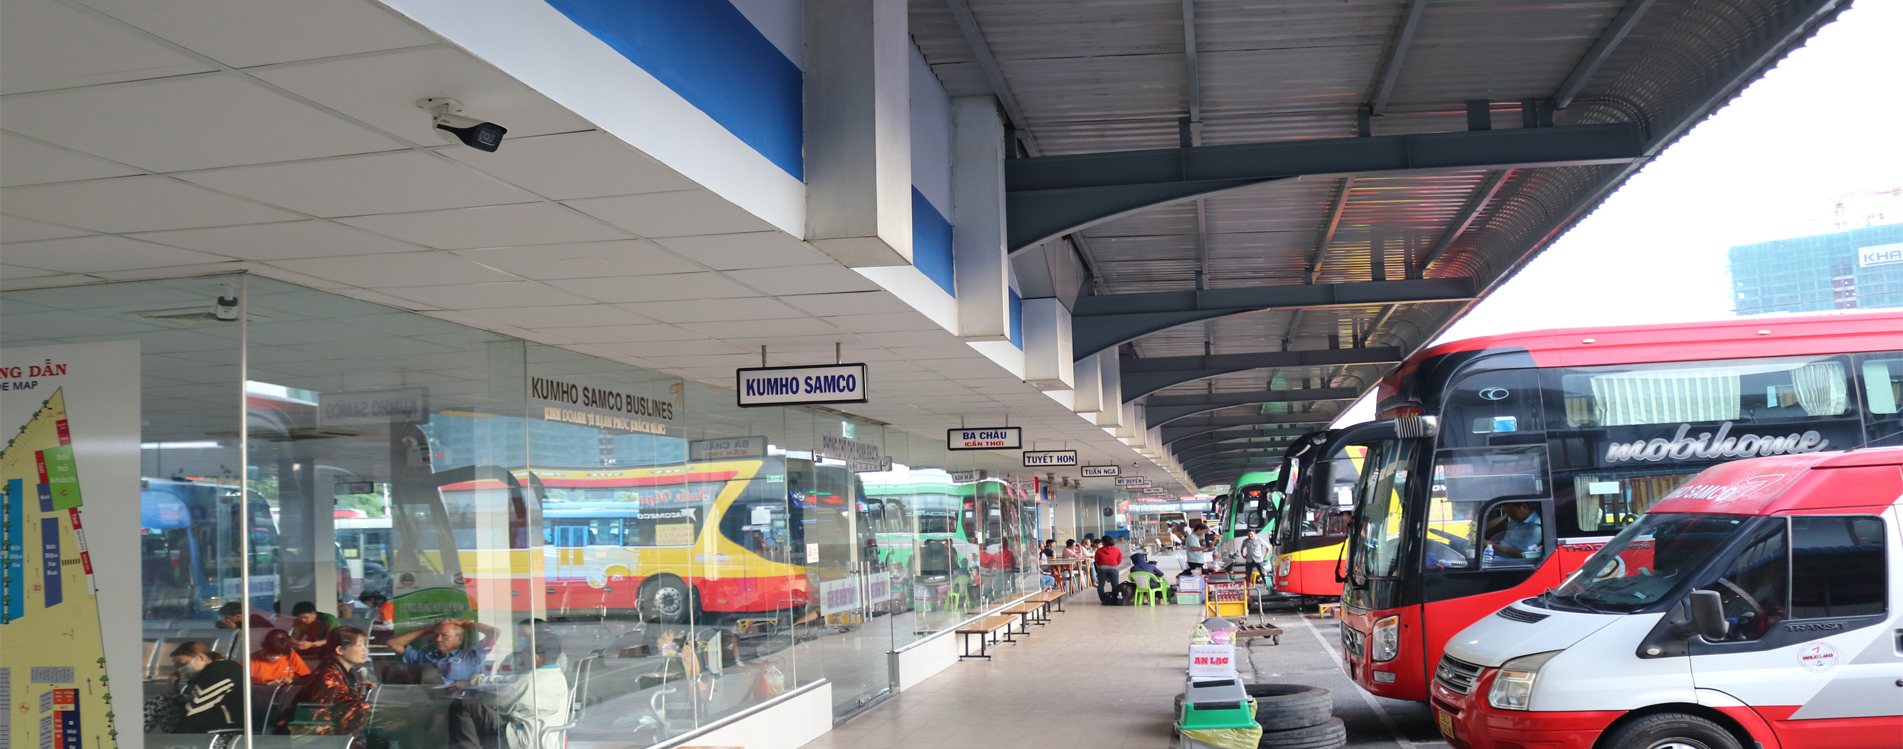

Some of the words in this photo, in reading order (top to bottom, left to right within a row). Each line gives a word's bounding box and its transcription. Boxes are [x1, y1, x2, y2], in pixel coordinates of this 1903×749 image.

[1864, 250, 1903, 262] KHA
[28, 359, 68, 377] DẪN
[13, 381, 38, 390] MAP
[746, 376, 800, 396] KUMHO
[804, 374, 856, 394] SAMCO
[532, 376, 578, 404] KUMHO
[582, 386, 623, 412] SAMCO
[626, 394, 673, 421] BUSLINES
[962, 432, 976, 440] BA
[979, 429, 1007, 440] CHÂU
[1605, 421, 1829, 463] mobihome
[1026, 452, 1054, 464] TUYẾT
[1056, 455, 1075, 464] HON
[1084, 467, 1102, 475] TUẤN
[1683, 484, 1737, 502] SAMCO
[1785, 622, 1847, 632] TRANSIT
[1194, 657, 1208, 665] AN
